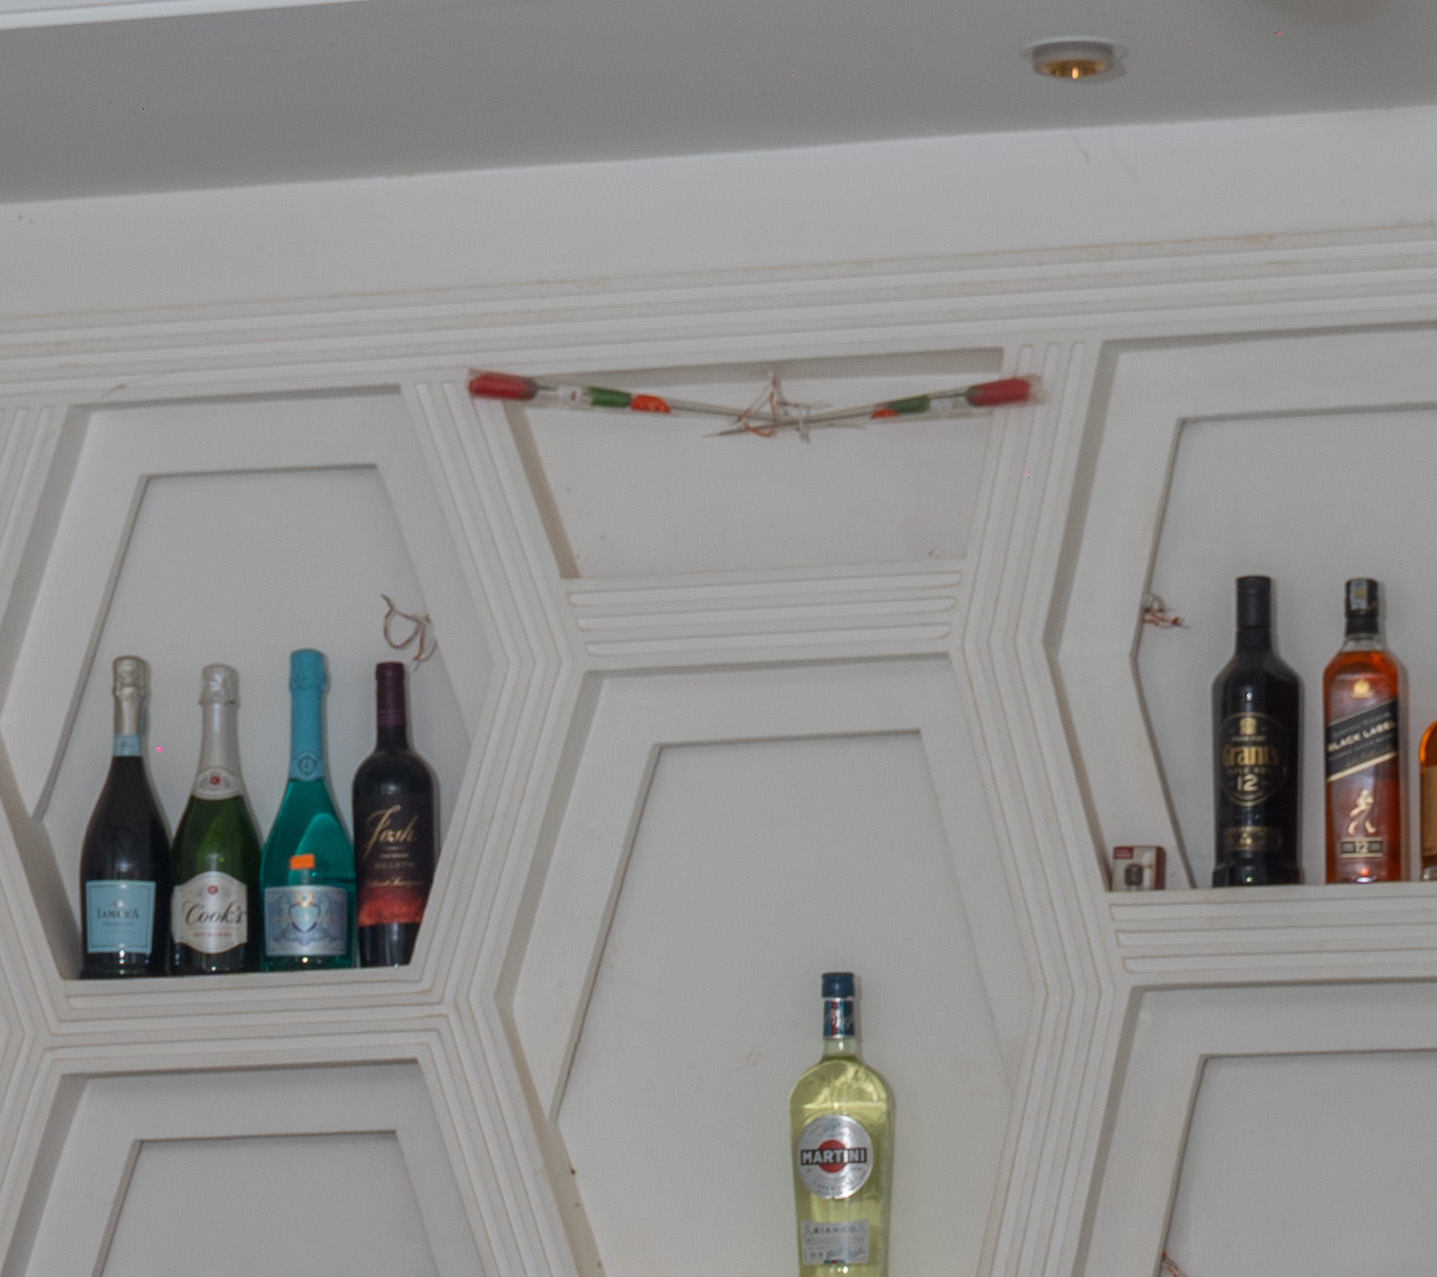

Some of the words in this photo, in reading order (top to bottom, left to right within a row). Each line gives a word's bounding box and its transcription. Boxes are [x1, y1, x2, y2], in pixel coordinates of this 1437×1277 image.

[1237, 774, 1258, 792] 12
[183, 899, 244, 926] Cook's
[802, 1148, 866, 1165] MARTINI
